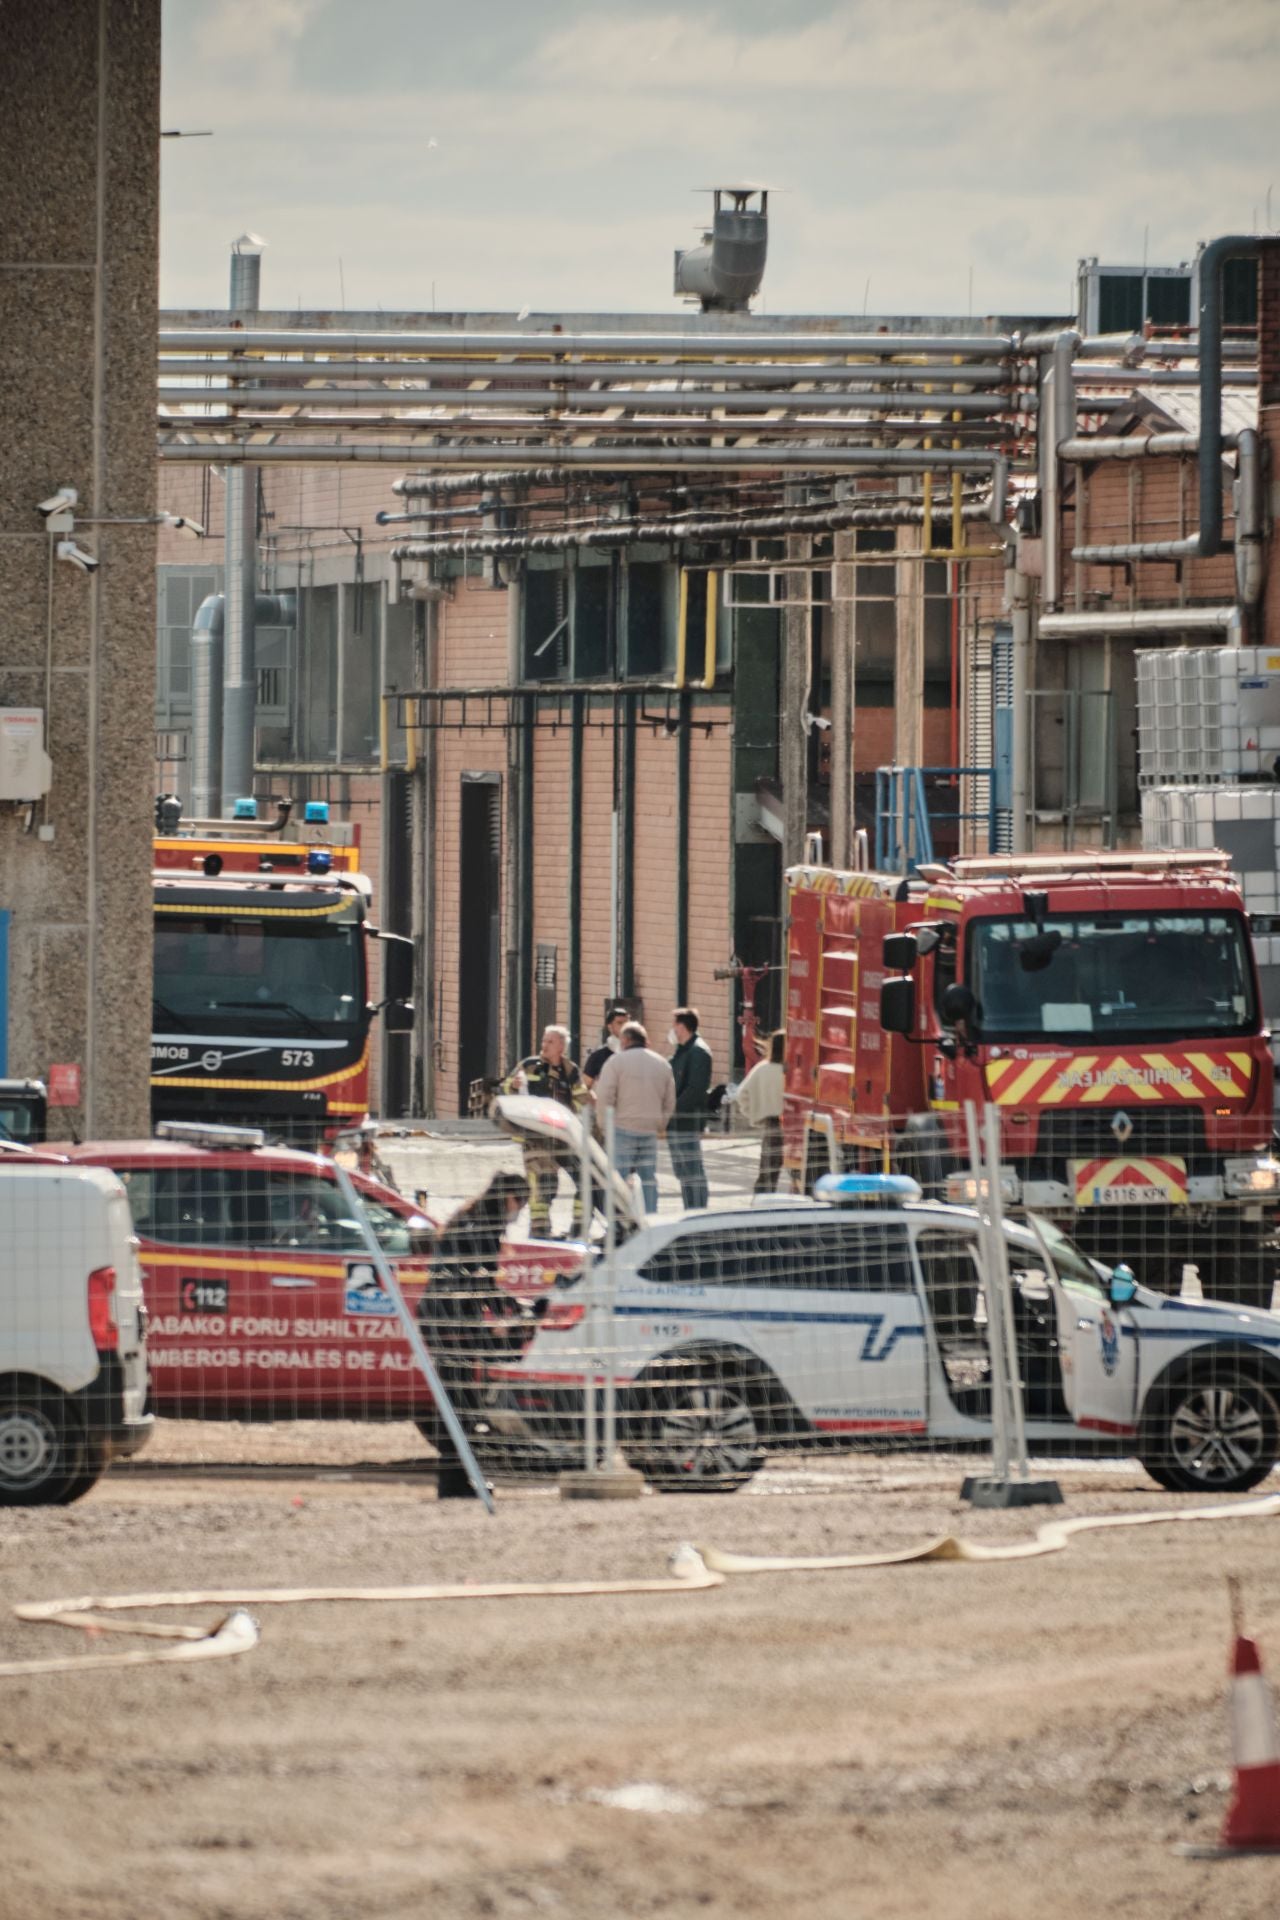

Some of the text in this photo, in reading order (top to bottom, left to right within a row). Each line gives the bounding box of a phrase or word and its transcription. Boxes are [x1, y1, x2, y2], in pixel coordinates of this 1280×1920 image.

[281, 1051, 314, 1066] 573
[195, 1287, 226, 1306] 112
[147, 1315, 225, 1336] ABAKO
[230, 1317, 289, 1336] FORU
[653, 1325, 679, 1336] 112
[149, 1348, 422, 1371] MBEROS FORALES DE ALA
